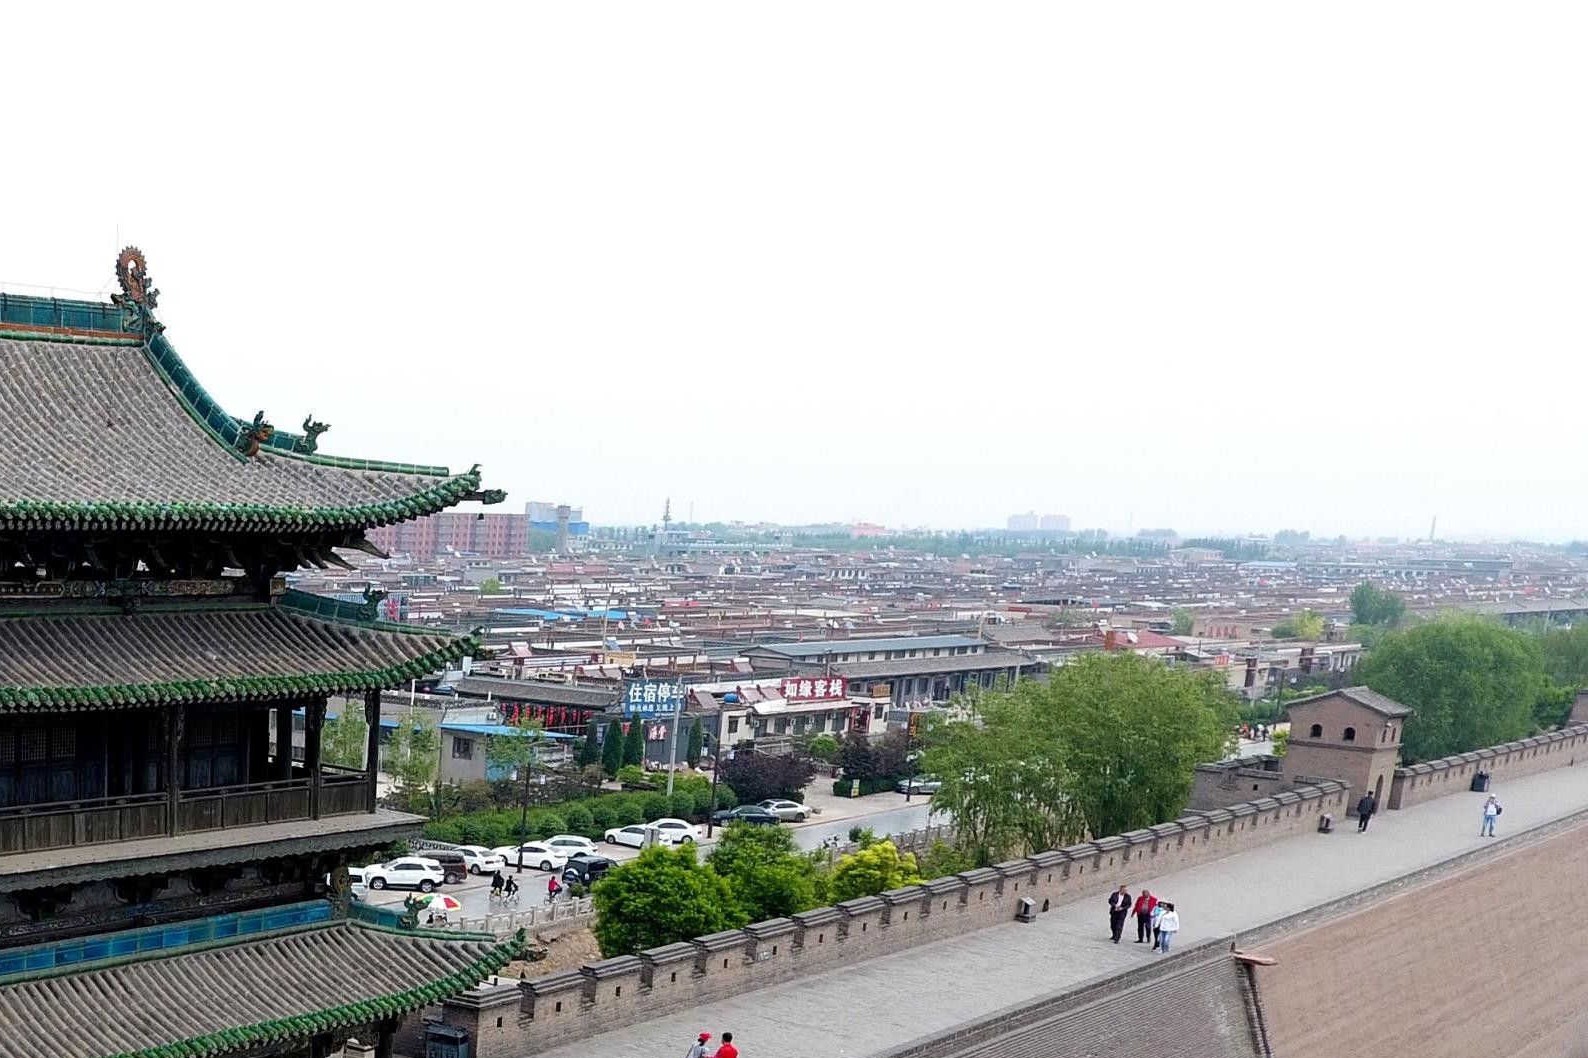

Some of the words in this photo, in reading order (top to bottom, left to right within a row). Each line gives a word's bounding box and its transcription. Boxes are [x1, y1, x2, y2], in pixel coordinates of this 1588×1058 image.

[628, 682, 684, 703] 住宿停车
[785, 679, 843, 698] 如缘客栈
